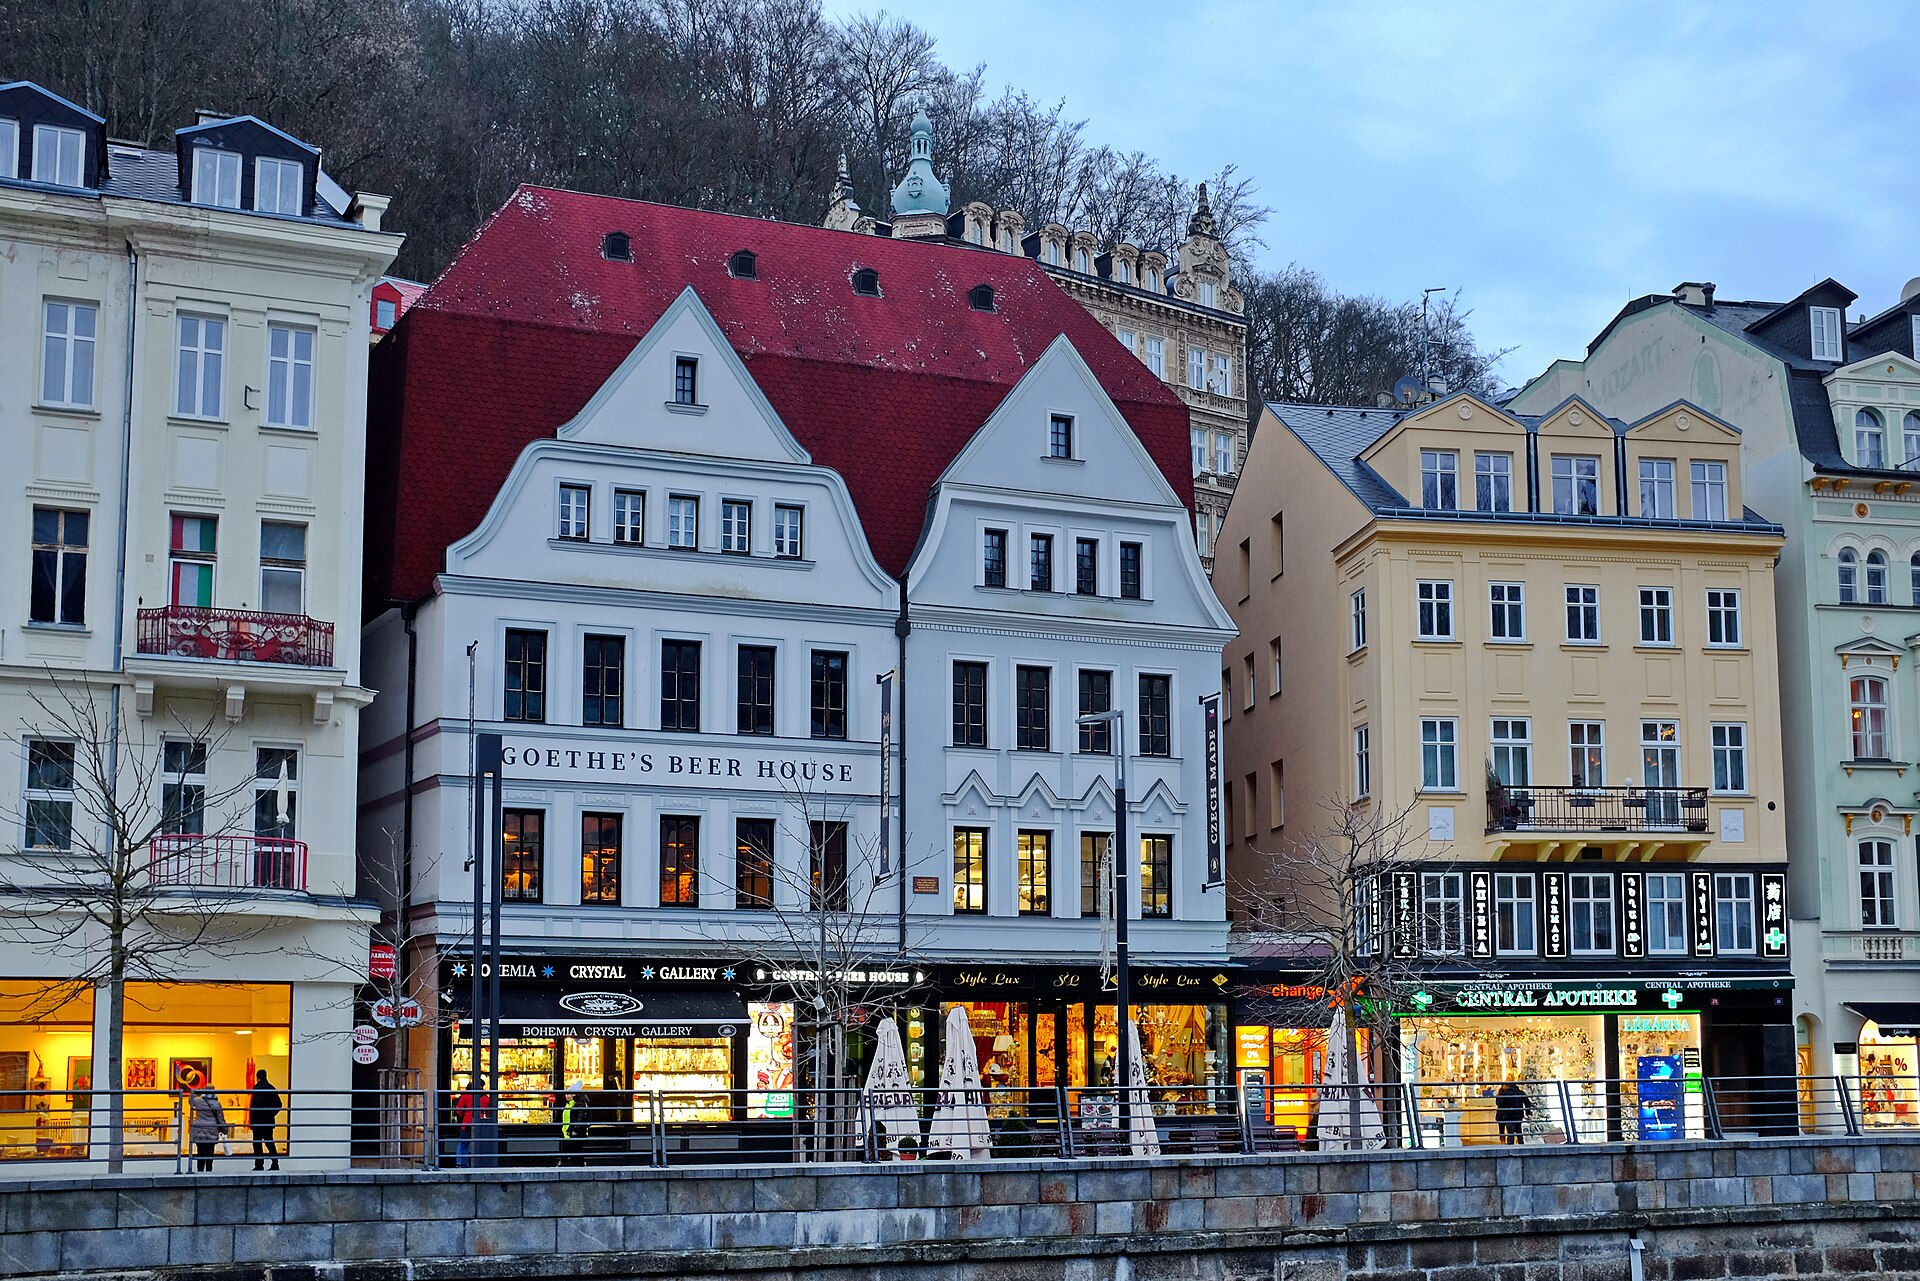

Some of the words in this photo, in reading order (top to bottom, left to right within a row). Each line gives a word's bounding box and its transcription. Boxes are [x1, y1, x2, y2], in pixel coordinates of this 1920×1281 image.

[1208, 729, 1217, 780] MADE
[502, 746, 653, 773] GOETHE'S
[668, 755, 742, 778] BEER
[757, 761, 853, 783] HOUSE
[1210, 786, 1218, 845] CZECH
[1475, 876, 1488, 953] АПТЕКА
[1550, 876, 1560, 953] PHARMACY
[569, 965, 626, 979] CRYSTAL
[659, 966, 717, 980] GALLERY
[869, 972, 910, 983] HOUSE
[954, 971, 987, 987] Style
[992, 972, 1020, 985] Lux
[1138, 972, 1169, 988] Style
[1176, 973, 1201, 986] Lux
[1507, 982, 1553, 990] APOTHEKE
[1645, 981, 1683, 989] CENTRAL
[1687, 981, 1731, 989] APOTHEKE
[1456, 991, 1537, 1007] CENTRAL
[1543, 989, 1638, 1006] APOTHEKE
[522, 1025, 578, 1036] BOHEMIA
[584, 1025, 636, 1036] CRYSTAL
[641, 1026, 693, 1036] GALLERY
[1623, 1016, 1690, 1033] LÉKÁRNA
